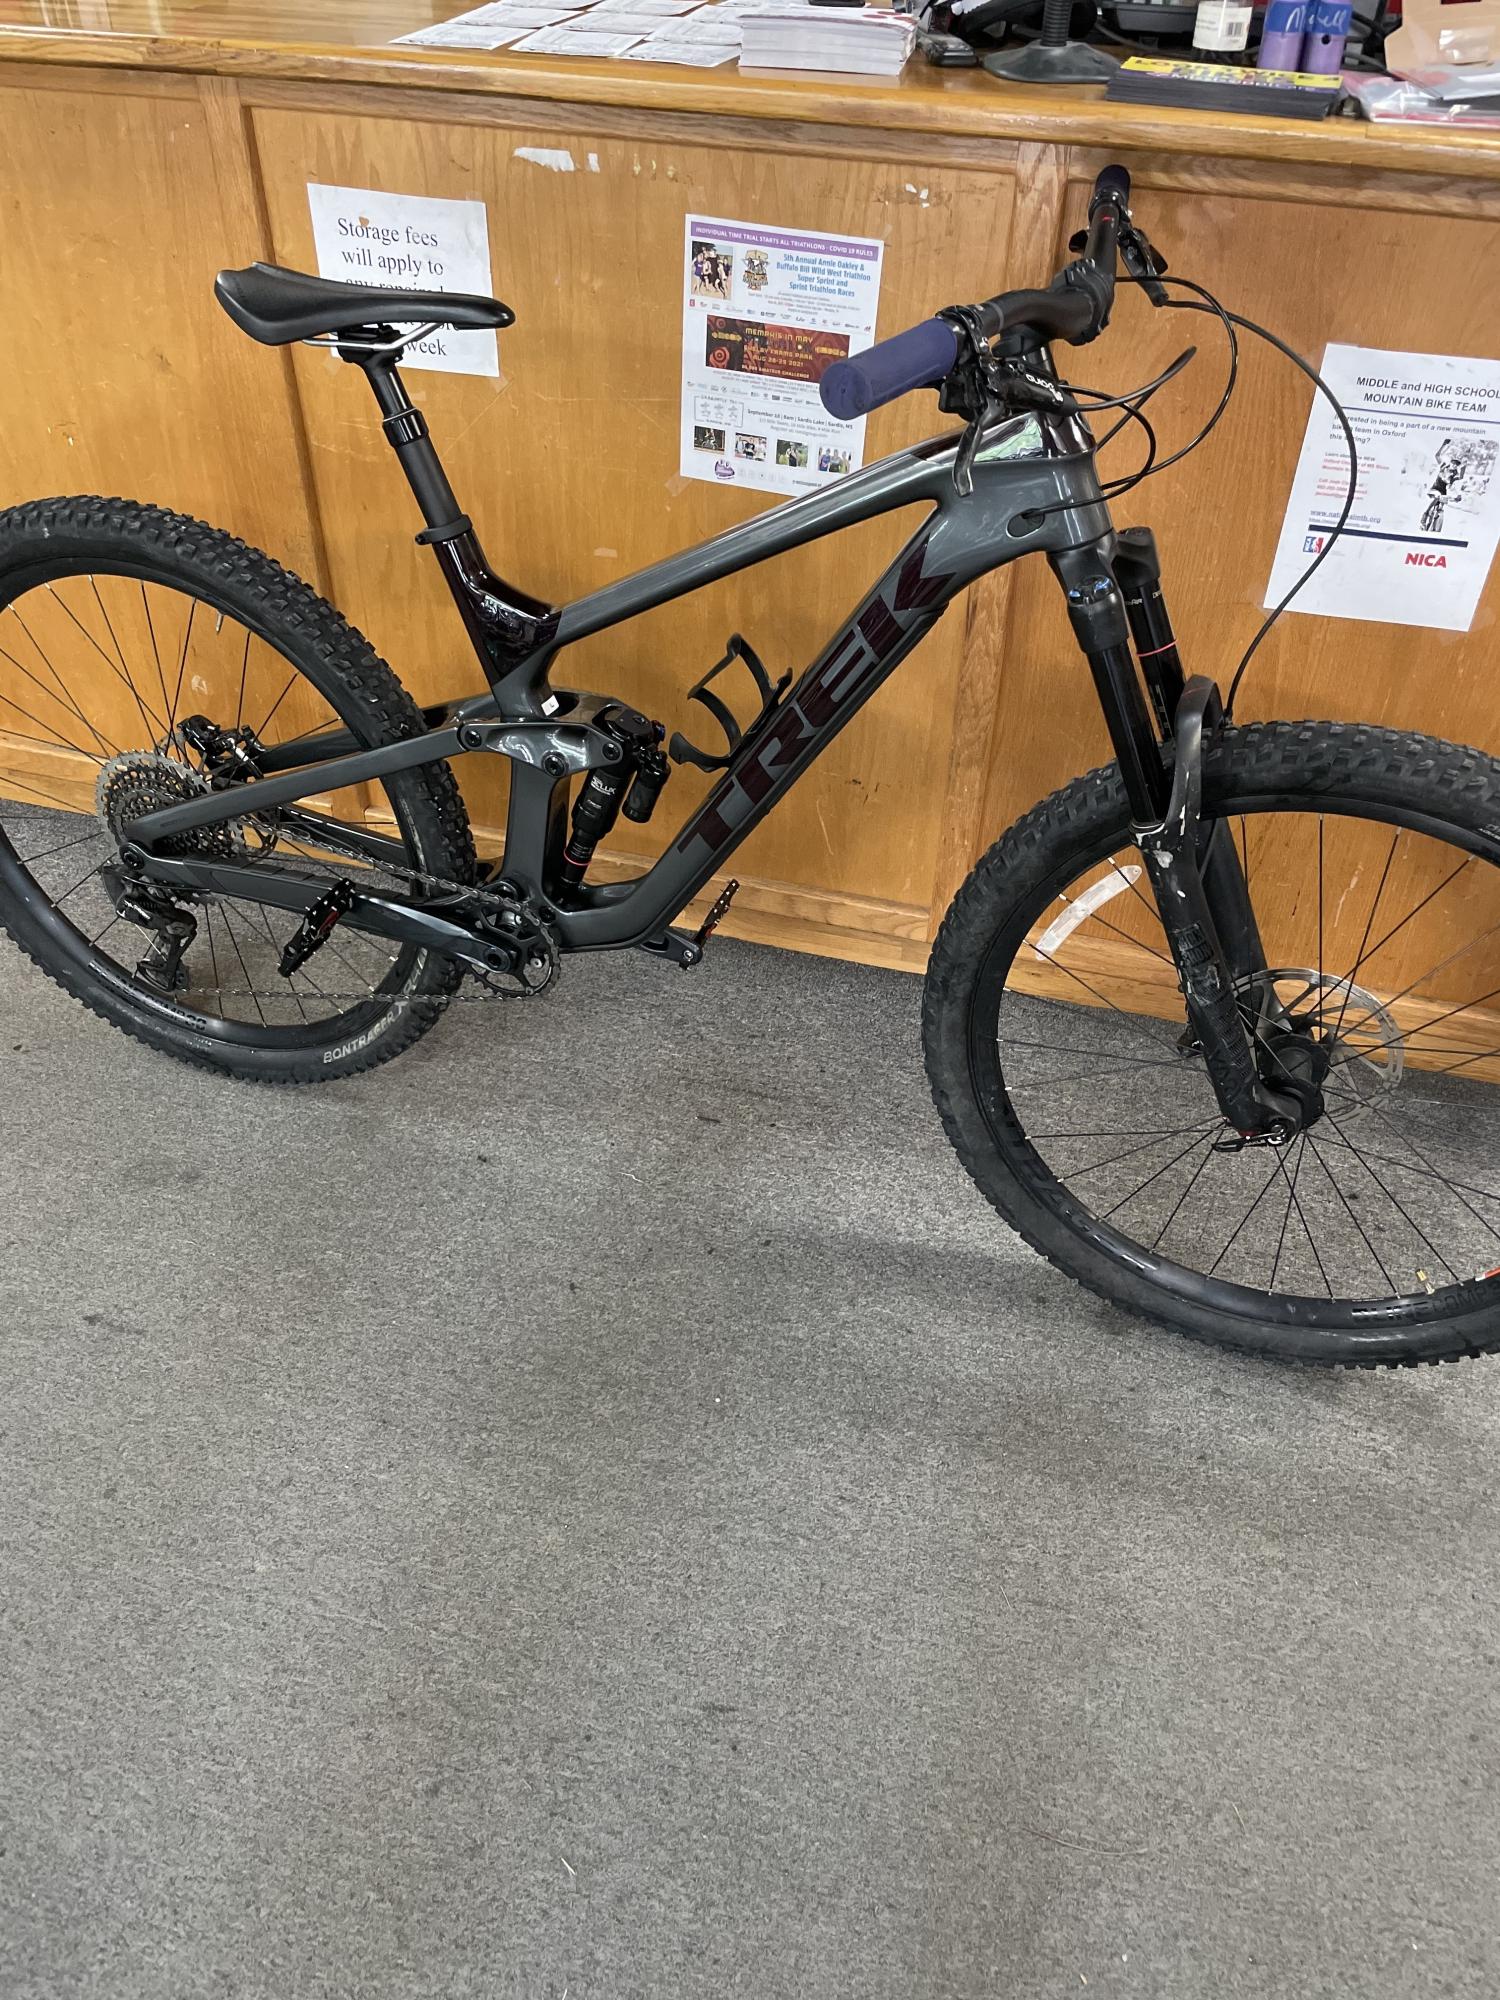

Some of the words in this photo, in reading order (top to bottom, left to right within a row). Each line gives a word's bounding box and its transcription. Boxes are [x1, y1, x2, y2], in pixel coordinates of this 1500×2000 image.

[337, 217, 400, 246] Storage
[405, 225, 438, 247] fees
[695, 226, 728, 238] INDIVIDUAL
[728, 231, 742, 239] TIME
[743, 233, 759, 241] TRIAL
[760, 236, 779, 245] STARTS
[791, 240, 826, 251] TRIATHLONS
[829, 245, 848, 254] COVID
[855, 248, 874, 257] RULES
[341, 247, 373, 267] will
[377, 254, 422, 277] apply
[428, 260, 444, 276] to
[776, 261, 799, 272] Buffalo
[799, 265, 810, 273] Bill
[811, 266, 826, 275] Wild
[827, 268, 843, 278] West
[843, 270, 871, 282] Triathlon
[783, 253, 794, 262] 5th
[795, 255, 817, 266] Annual
[818, 258, 836, 268] Annie
[837, 260, 859, 272] Oakley
[859, 263, 865, 272] &
[789, 281, 808, 292] Sprint
[809, 284, 837, 295] Triathlon
[837, 288, 855, 298] Races
[797, 274, 816, 284] Super
[816, 276, 835, 286] Sprint
[836, 280, 849, 288] and
[745, 327, 783, 340] MEMPHIS
[795, 335, 813, 344] MAY
[406, 338, 448, 357] week
[1356, 376, 1399, 390] MIDDLE
[1400, 381, 1422, 392] and
[1423, 383, 1452, 395] HIGH
[1454, 386, 1500, 400] SCHOOL
[1363, 392, 1424, 408] MOUNTAIN
[1425, 397, 1452, 411] BIKE
[1456, 401, 1488, 414] TEAM
[1354, 425, 1372, 434] team
[1381, 429, 1406, 438] Oxford
[1378, 418, 1399, 428] being
[1405, 422, 1421, 430] part
[1421, 423, 1430, 431] of
[1452, 426, 1486, 435] mountain
[1329, 433, 1342, 441] this
[1404, 552, 1447, 569] NICA
[677, 531, 957, 853] TREK
[323, 1010, 396, 1064] BONTRAGER
